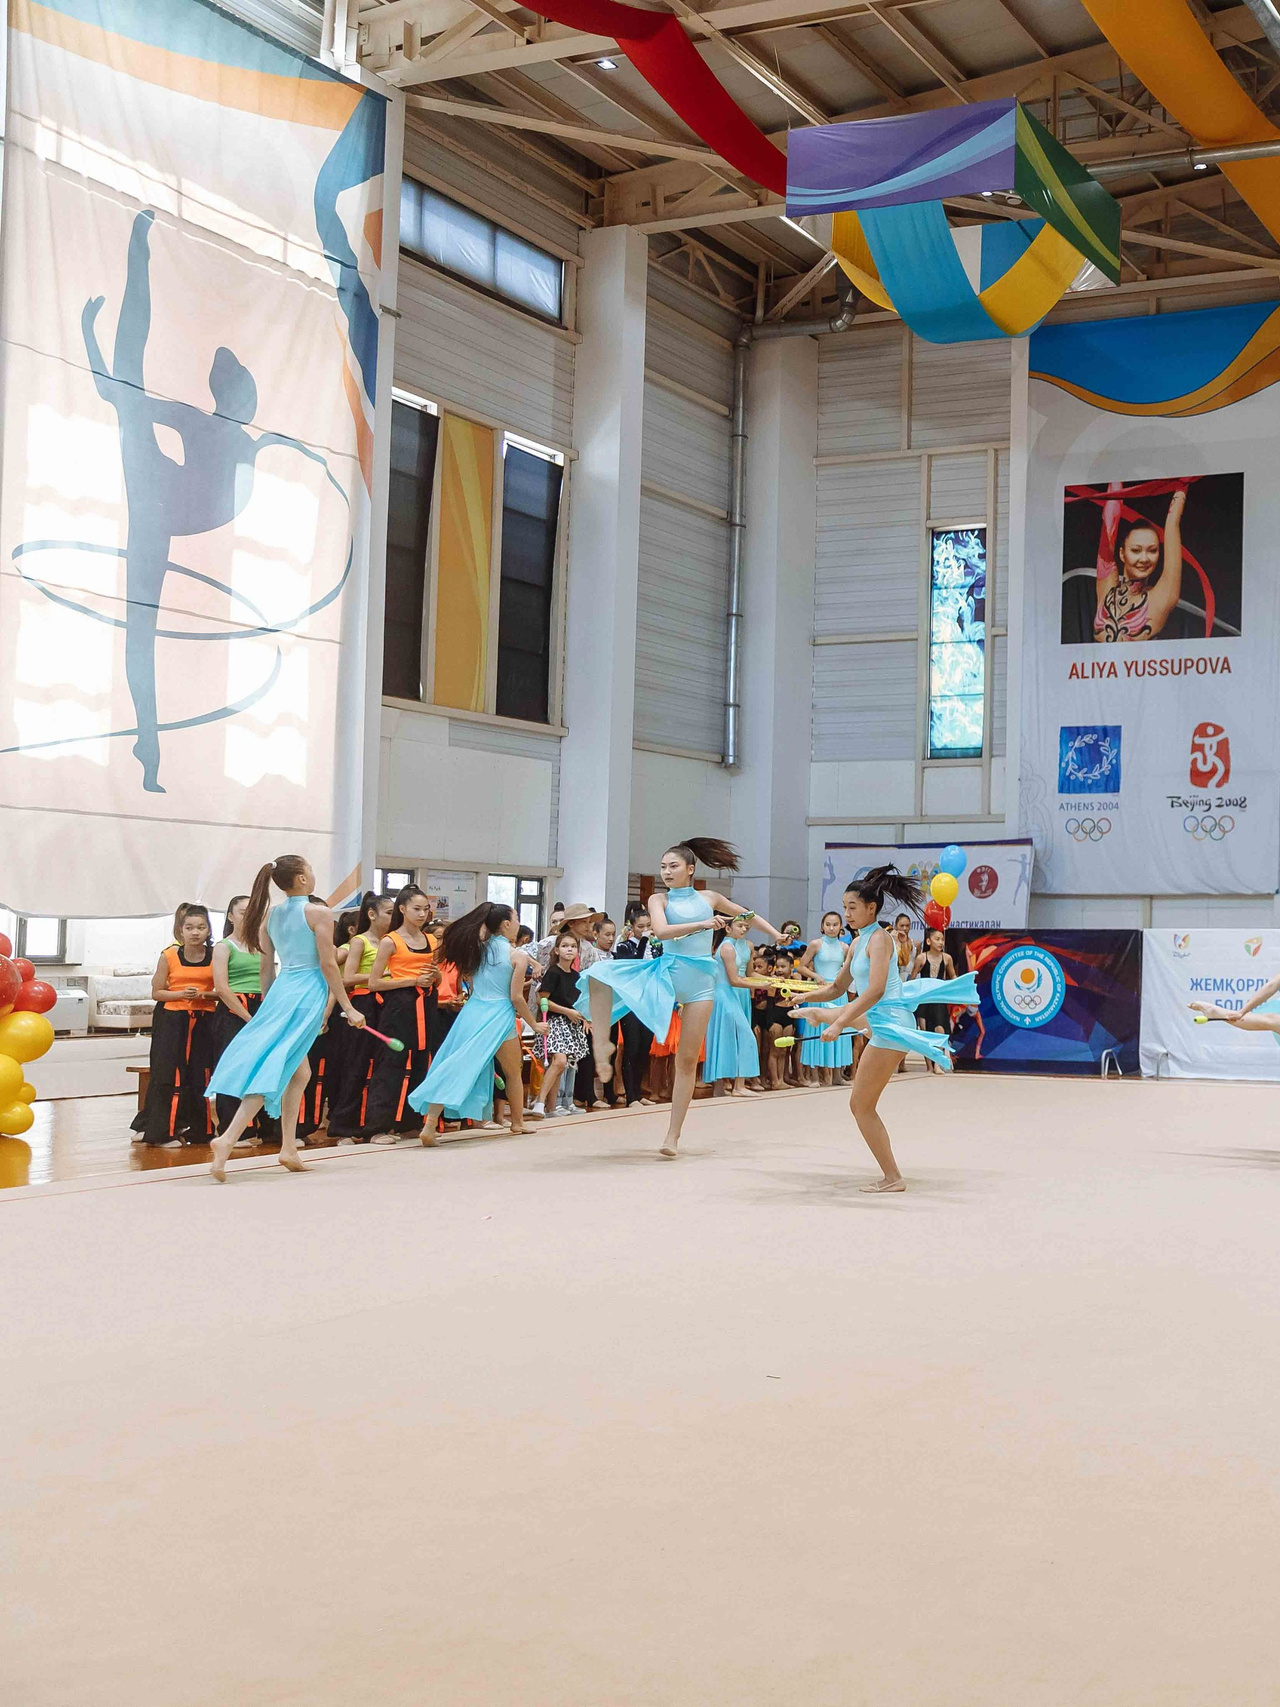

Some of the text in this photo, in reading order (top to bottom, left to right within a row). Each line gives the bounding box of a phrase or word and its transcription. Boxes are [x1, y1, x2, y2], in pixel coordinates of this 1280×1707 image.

[1068, 656, 1232, 680] ALIYA YUSSUPOVA
[1058, 801, 1119, 812] ATHENS 2004
[1166, 795, 1248, 812] Beijing 2008
